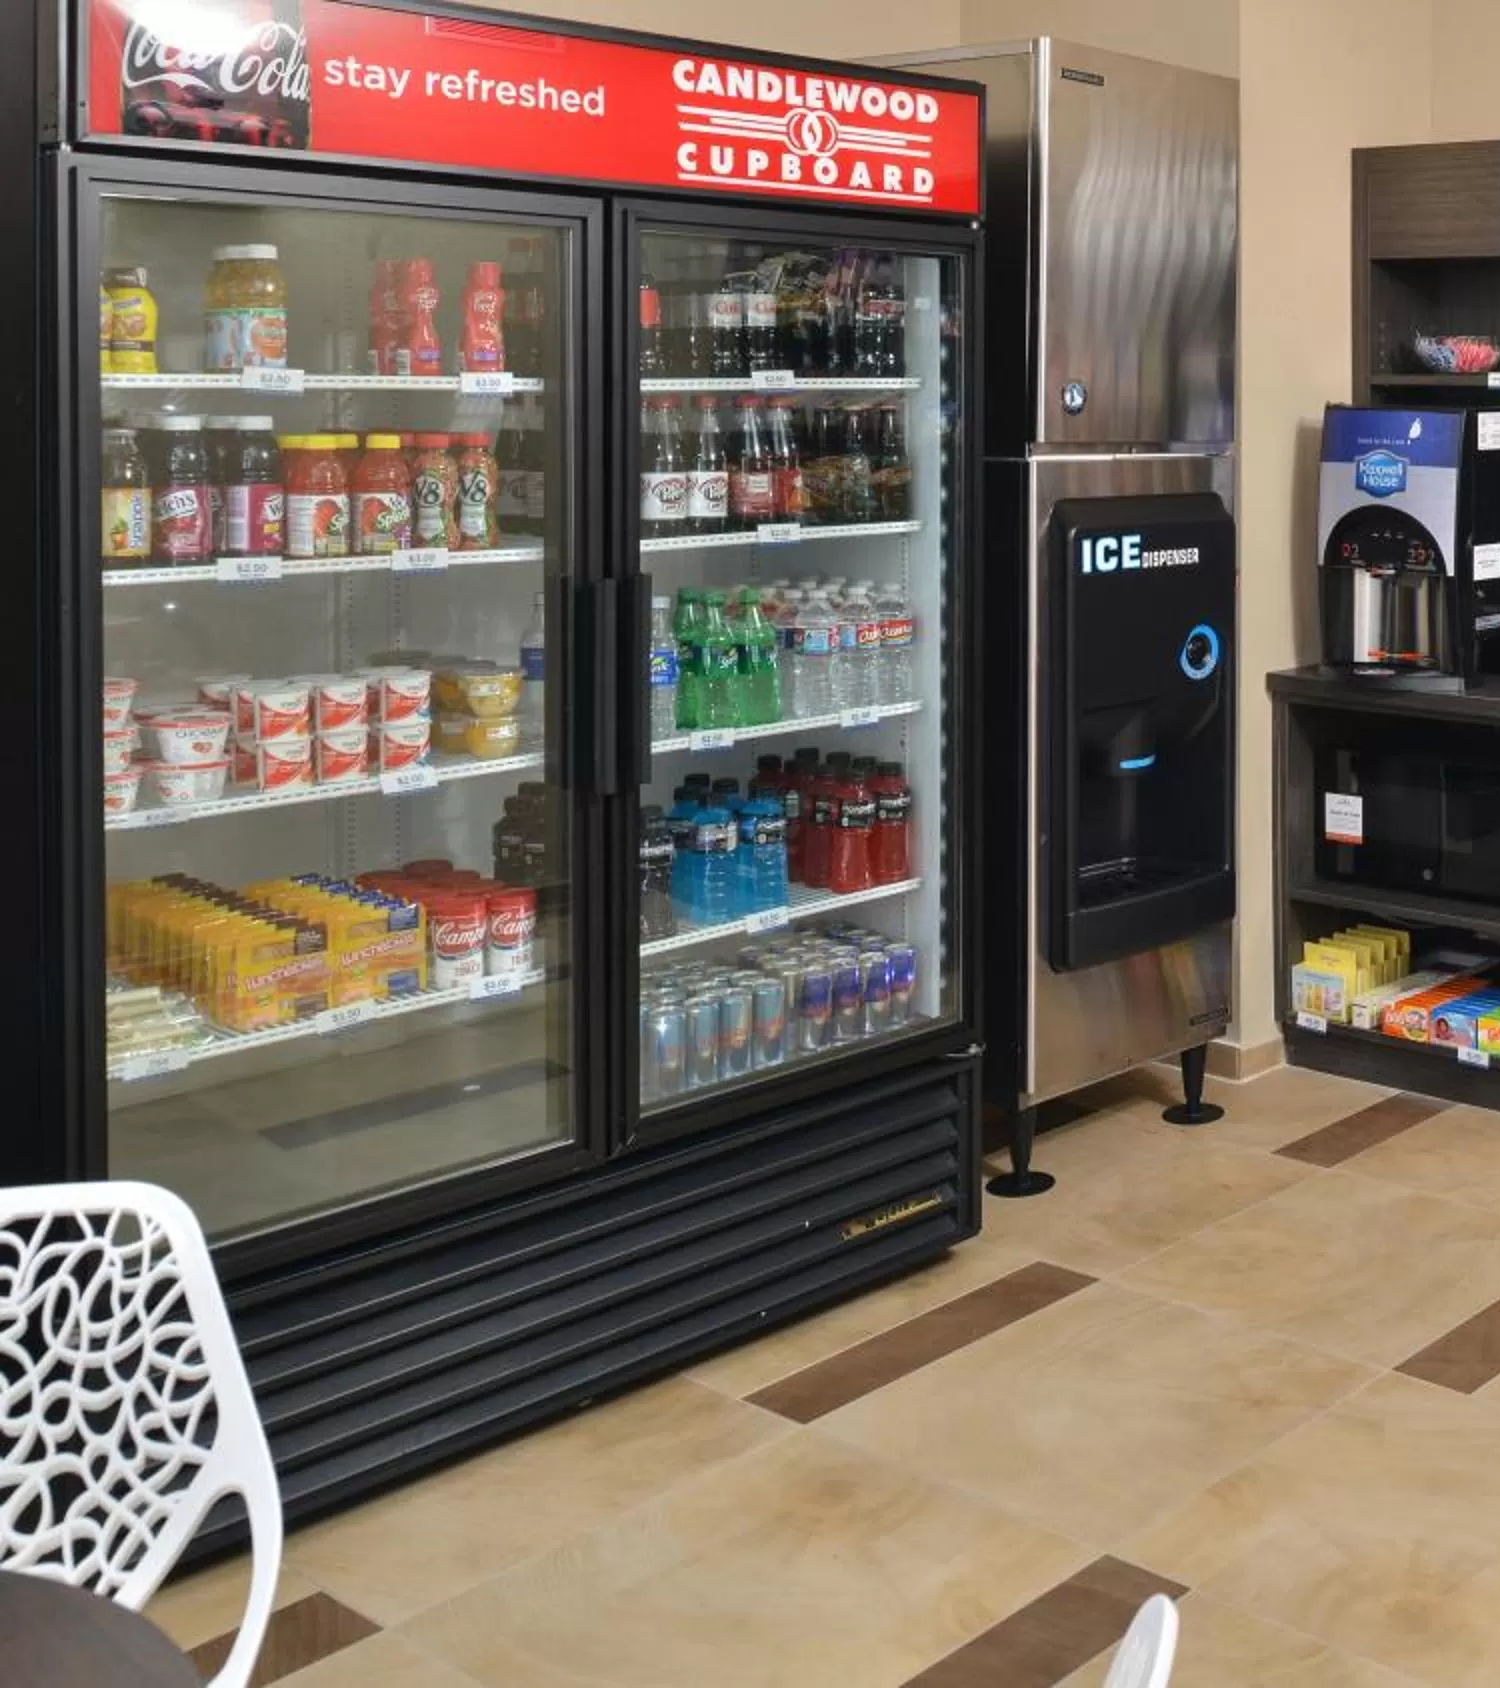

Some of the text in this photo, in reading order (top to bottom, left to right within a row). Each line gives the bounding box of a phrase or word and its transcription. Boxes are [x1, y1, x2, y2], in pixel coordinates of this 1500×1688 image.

[323, 57, 606, 118] stay refreshed
[672, 59, 939, 124] CANDLEWOOD
[677, 141, 935, 194] CUPBOARD
[1359, 460, 1403, 475] Maxwell
[1362, 474, 1400, 488] House
[1081, 534, 1200, 574] ICE DISPENSER
